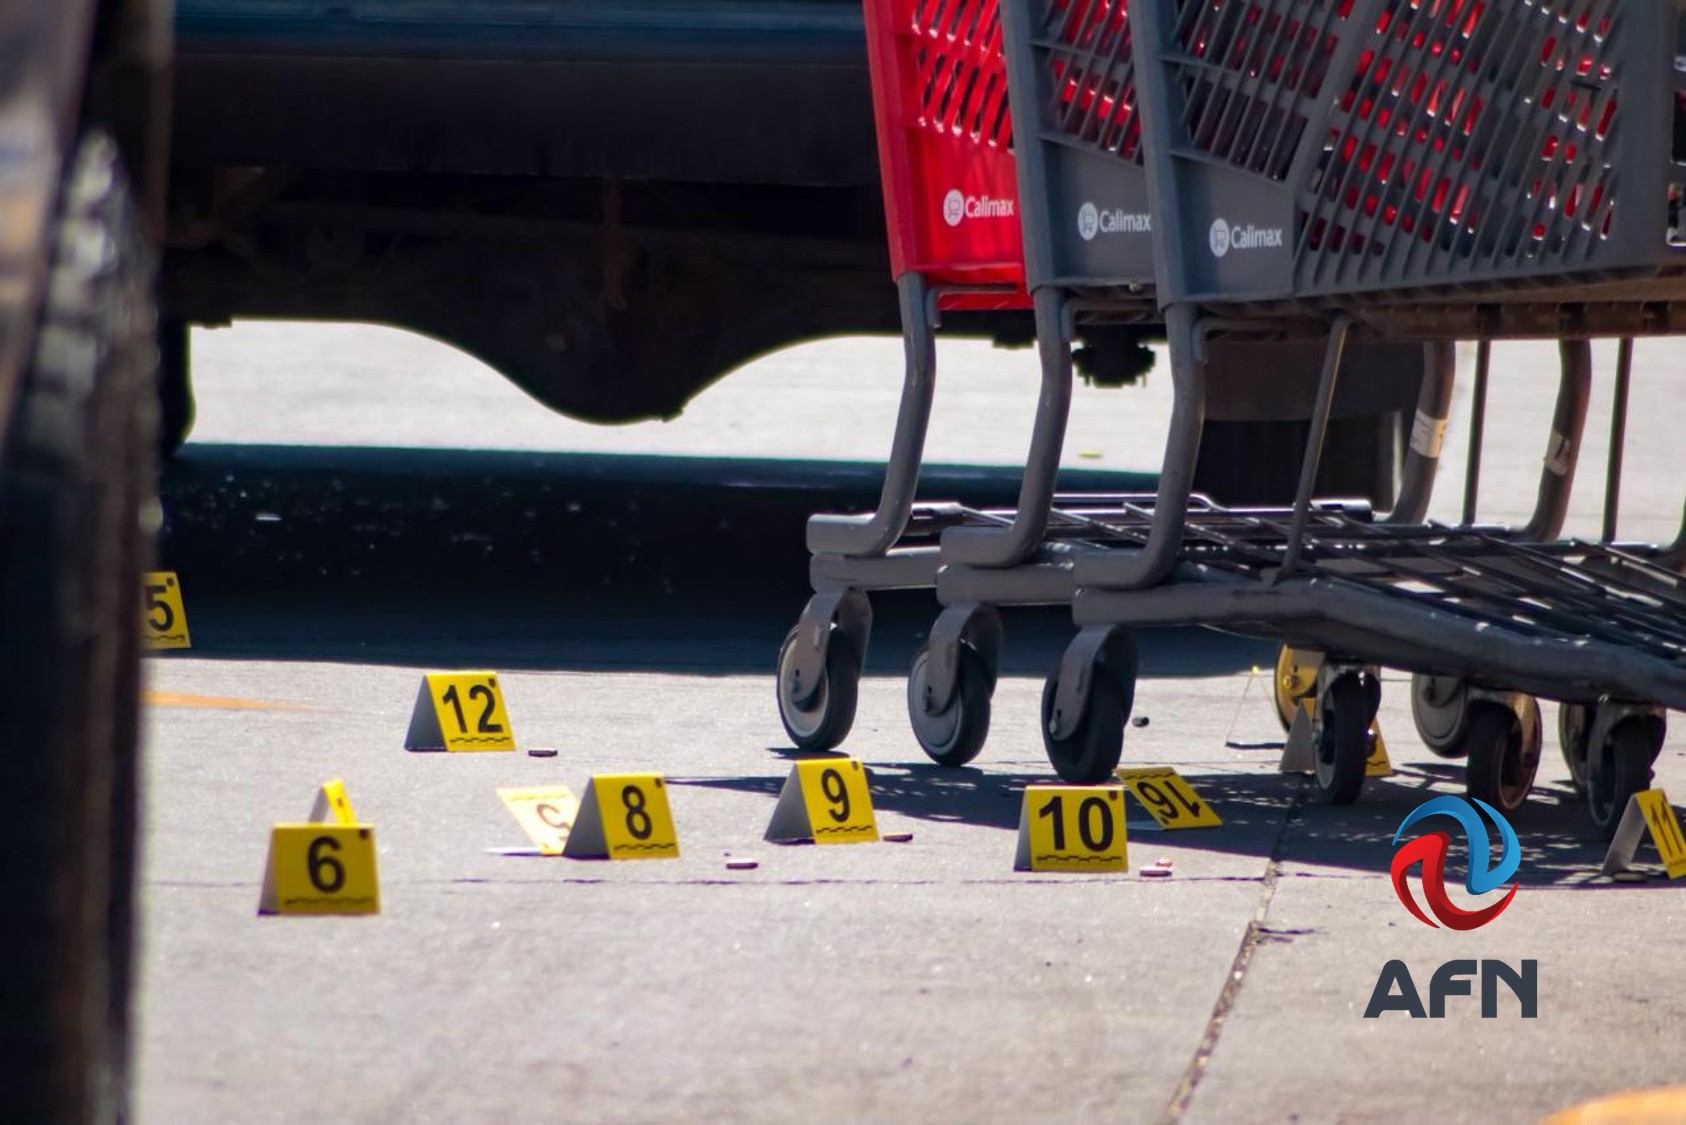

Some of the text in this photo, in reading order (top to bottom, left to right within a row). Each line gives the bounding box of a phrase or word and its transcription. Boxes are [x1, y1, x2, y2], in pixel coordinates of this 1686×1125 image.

[965, 196, 1014, 218] Calimax
[1099, 210, 1151, 232] Calimax
[1231, 224, 1282, 249] Calimax
[442, 684, 504, 734] 12
[621, 784, 653, 841] 8
[820, 768, 851, 823] 9
[1039, 795, 1114, 853] 10
[306, 836, 347, 894] 6
